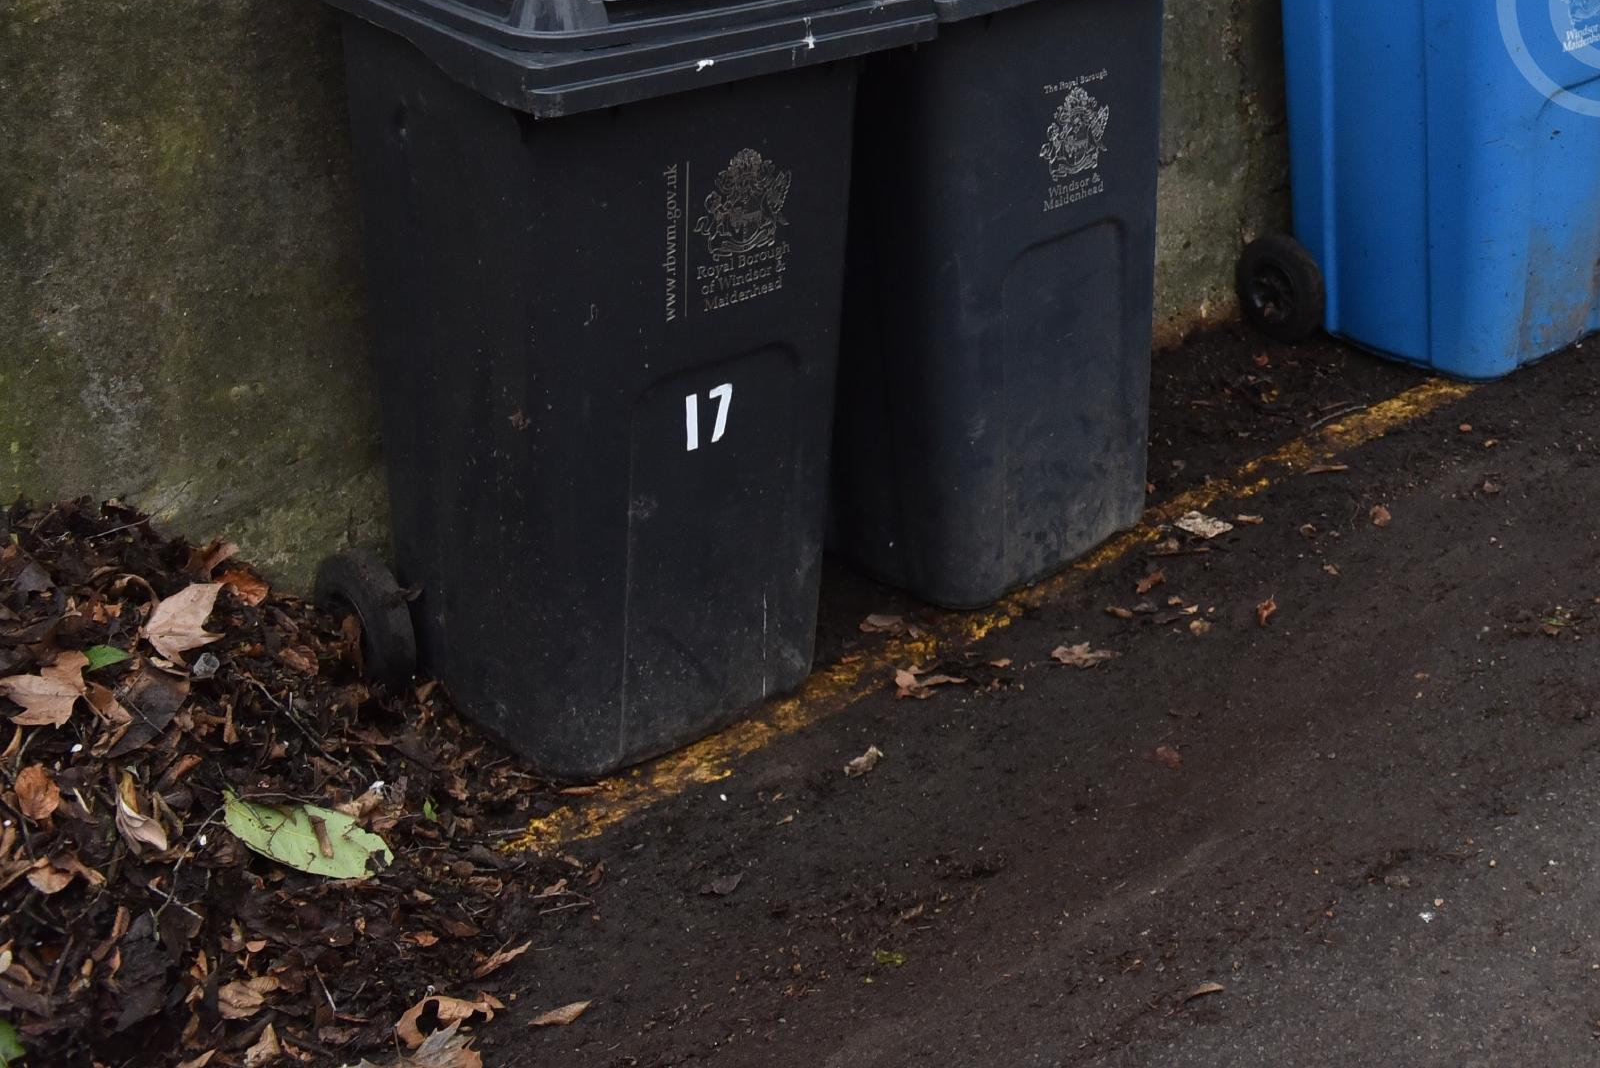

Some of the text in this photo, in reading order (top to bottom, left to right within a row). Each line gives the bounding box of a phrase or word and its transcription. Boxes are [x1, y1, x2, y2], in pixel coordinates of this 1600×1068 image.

[1566, 24, 1599, 42] Windsor
[1043, 68, 1108, 94] The Royal Borough
[1043, 180, 1104, 212] Maidenhead
[1048, 172, 1101, 198] Windsor &
[662, 163, 682, 323] www.rbwm.gov.uk
[697, 241, 790, 280] Royal Borough
[701, 259, 786, 295] of Windsor &
[703, 276, 782, 312] Maidenhead
[685, 382, 733, 452] 17
